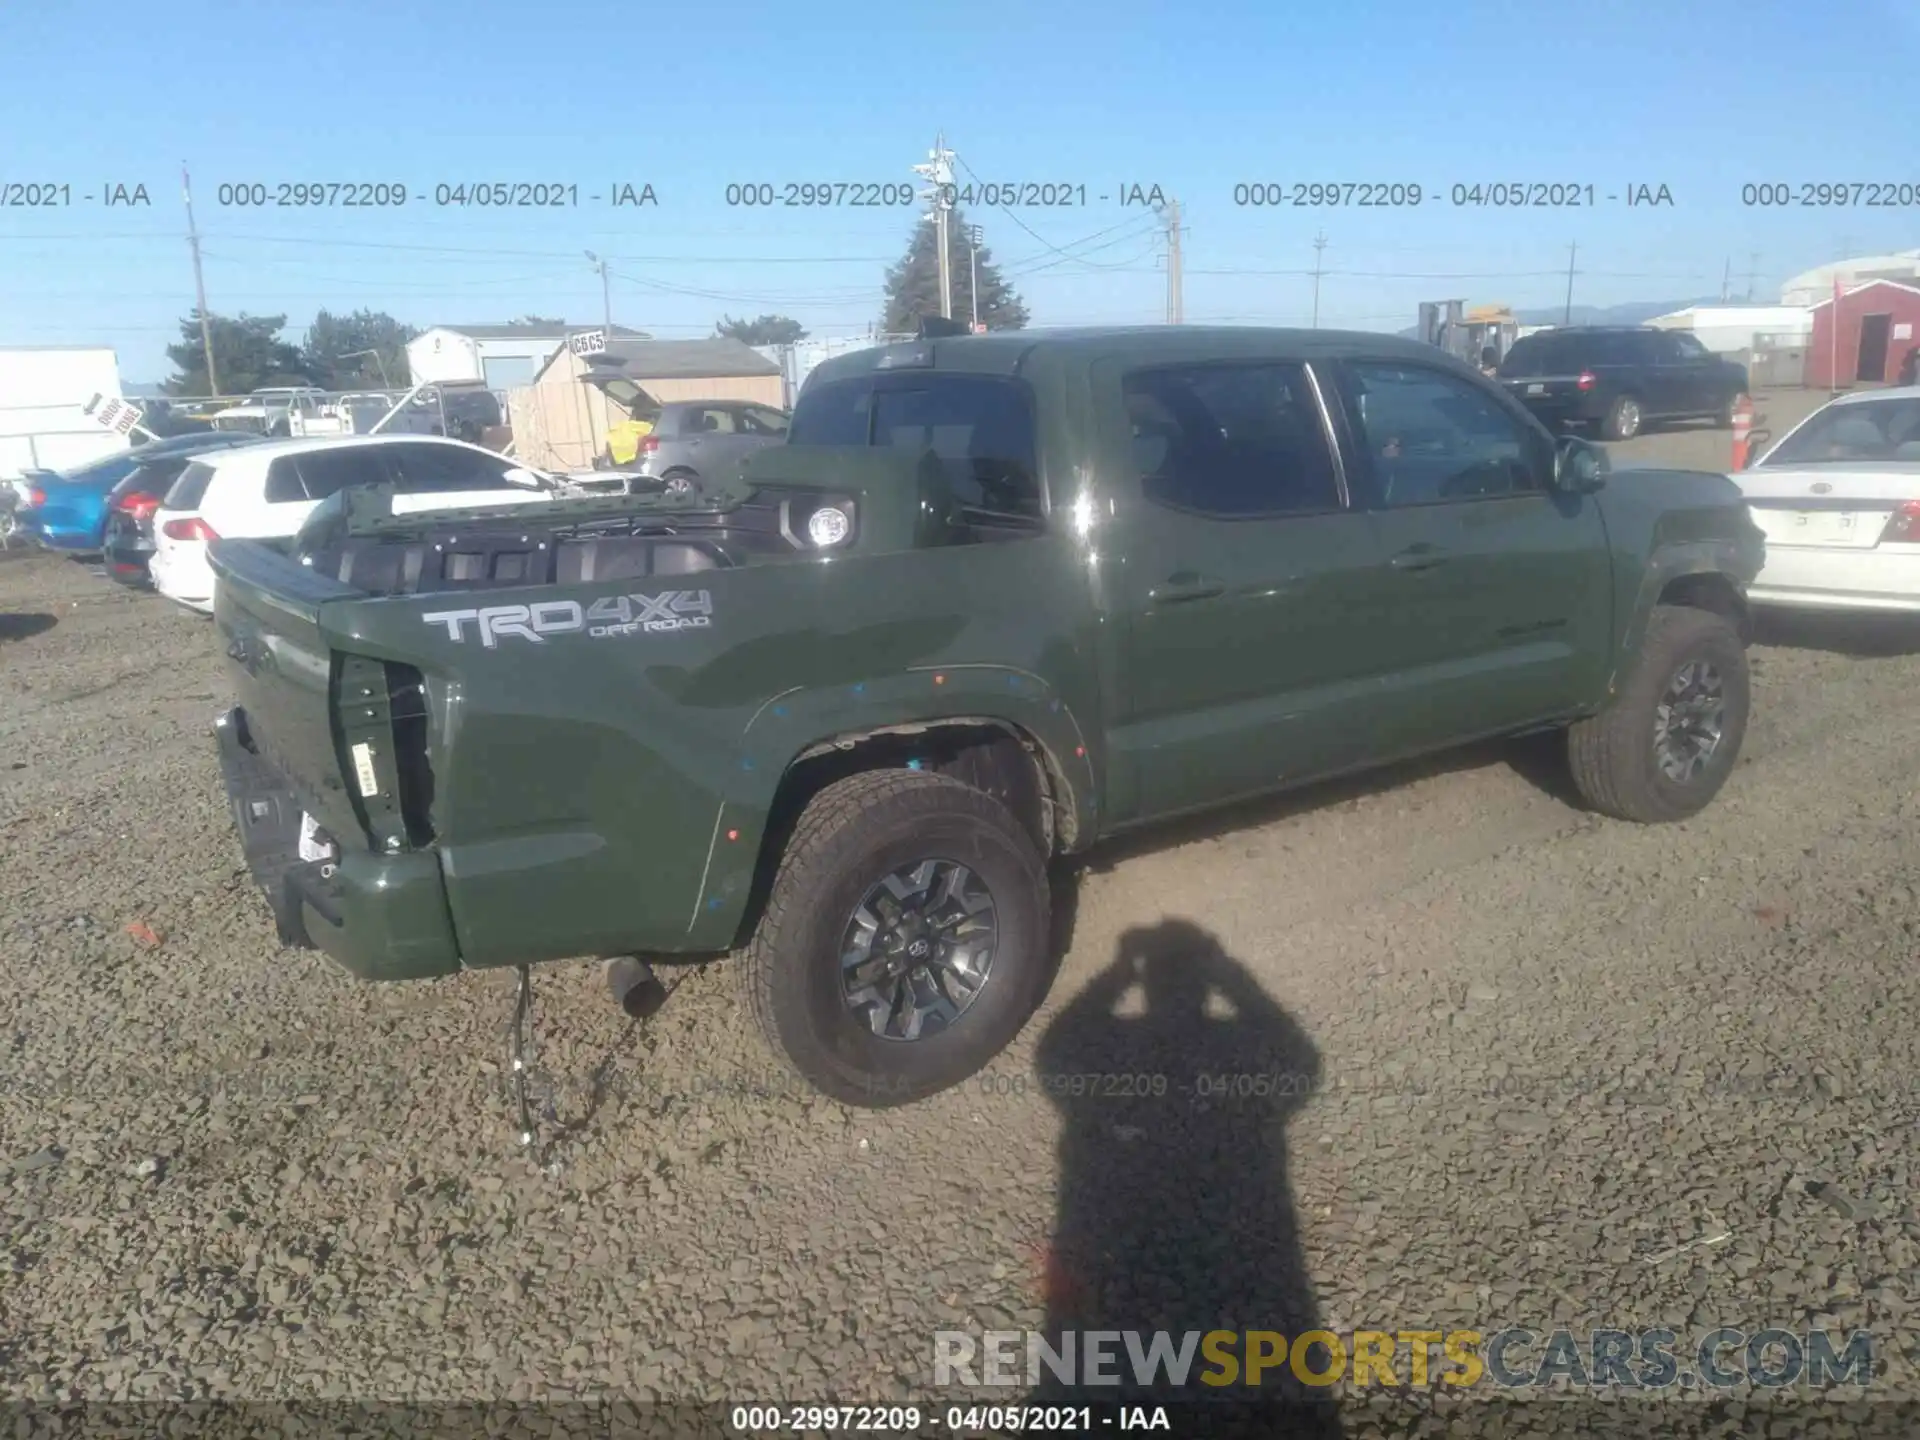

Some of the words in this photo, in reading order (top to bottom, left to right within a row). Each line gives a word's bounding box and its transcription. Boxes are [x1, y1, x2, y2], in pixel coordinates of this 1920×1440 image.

[98, 398, 122, 426] DROP
[422, 600, 585, 649] TRD
[589, 622, 637, 638] OFF
[643, 614, 711, 633] ROAD
